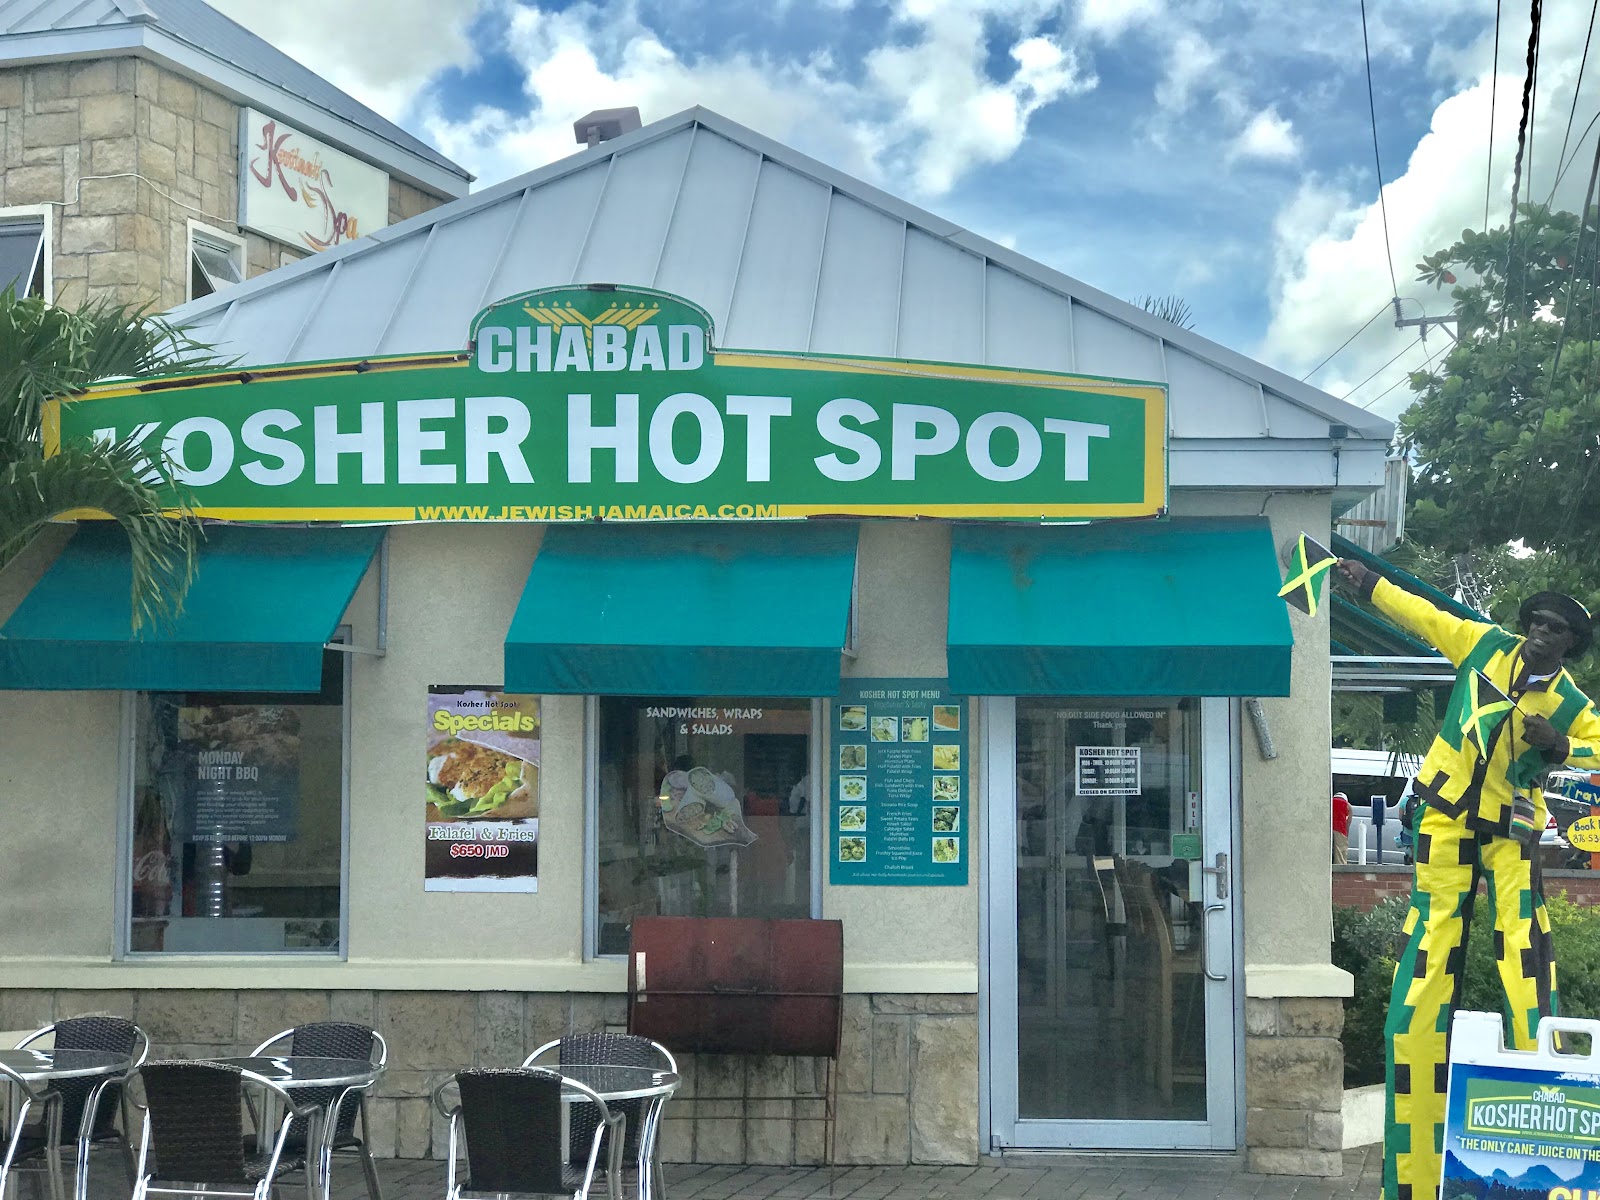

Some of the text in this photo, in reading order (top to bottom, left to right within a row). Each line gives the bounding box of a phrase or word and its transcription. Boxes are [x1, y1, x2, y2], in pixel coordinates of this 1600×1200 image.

[477, 323, 704, 373] CHABAD
[567, 393, 792, 484] HOT
[813, 398, 1110, 482] SPOT
[418, 503, 778, 520] WWW.JEWISHJAMAICA.COM
[860, 690, 940, 699] KOSHER HOT SPOT MENU
[457, 700, 484, 708] Kosher
[500, 701, 517, 709] Spot
[646, 707, 763, 720] SANDWICHES, WRAPS
[1069, 711, 1083, 719] OUT
[1084, 711, 1099, 719] SIDE
[1101, 711, 1120, 719] FOOD
[1121, 711, 1154, 719] ALLOWED
[433, 709, 534, 735] Specials
[1093, 721, 1127, 730] Thank you
[680, 724, 733, 735] & SALADS
[198, 751, 244, 765] MONDAY
[198, 767, 259, 781] NIGHT BBQ
[1574, 818, 1595, 831] Book
[428, 825, 534, 841] Falafel & Fries
[451, 845, 509, 857] $650 JMD
[1532, 1090, 1565, 1103] CHABAD
[1473, 1103, 1600, 1135] KOSHER HOT SP
[1455, 1135, 1600, 1162] "THE ONLY CANE JUICE ON THE
